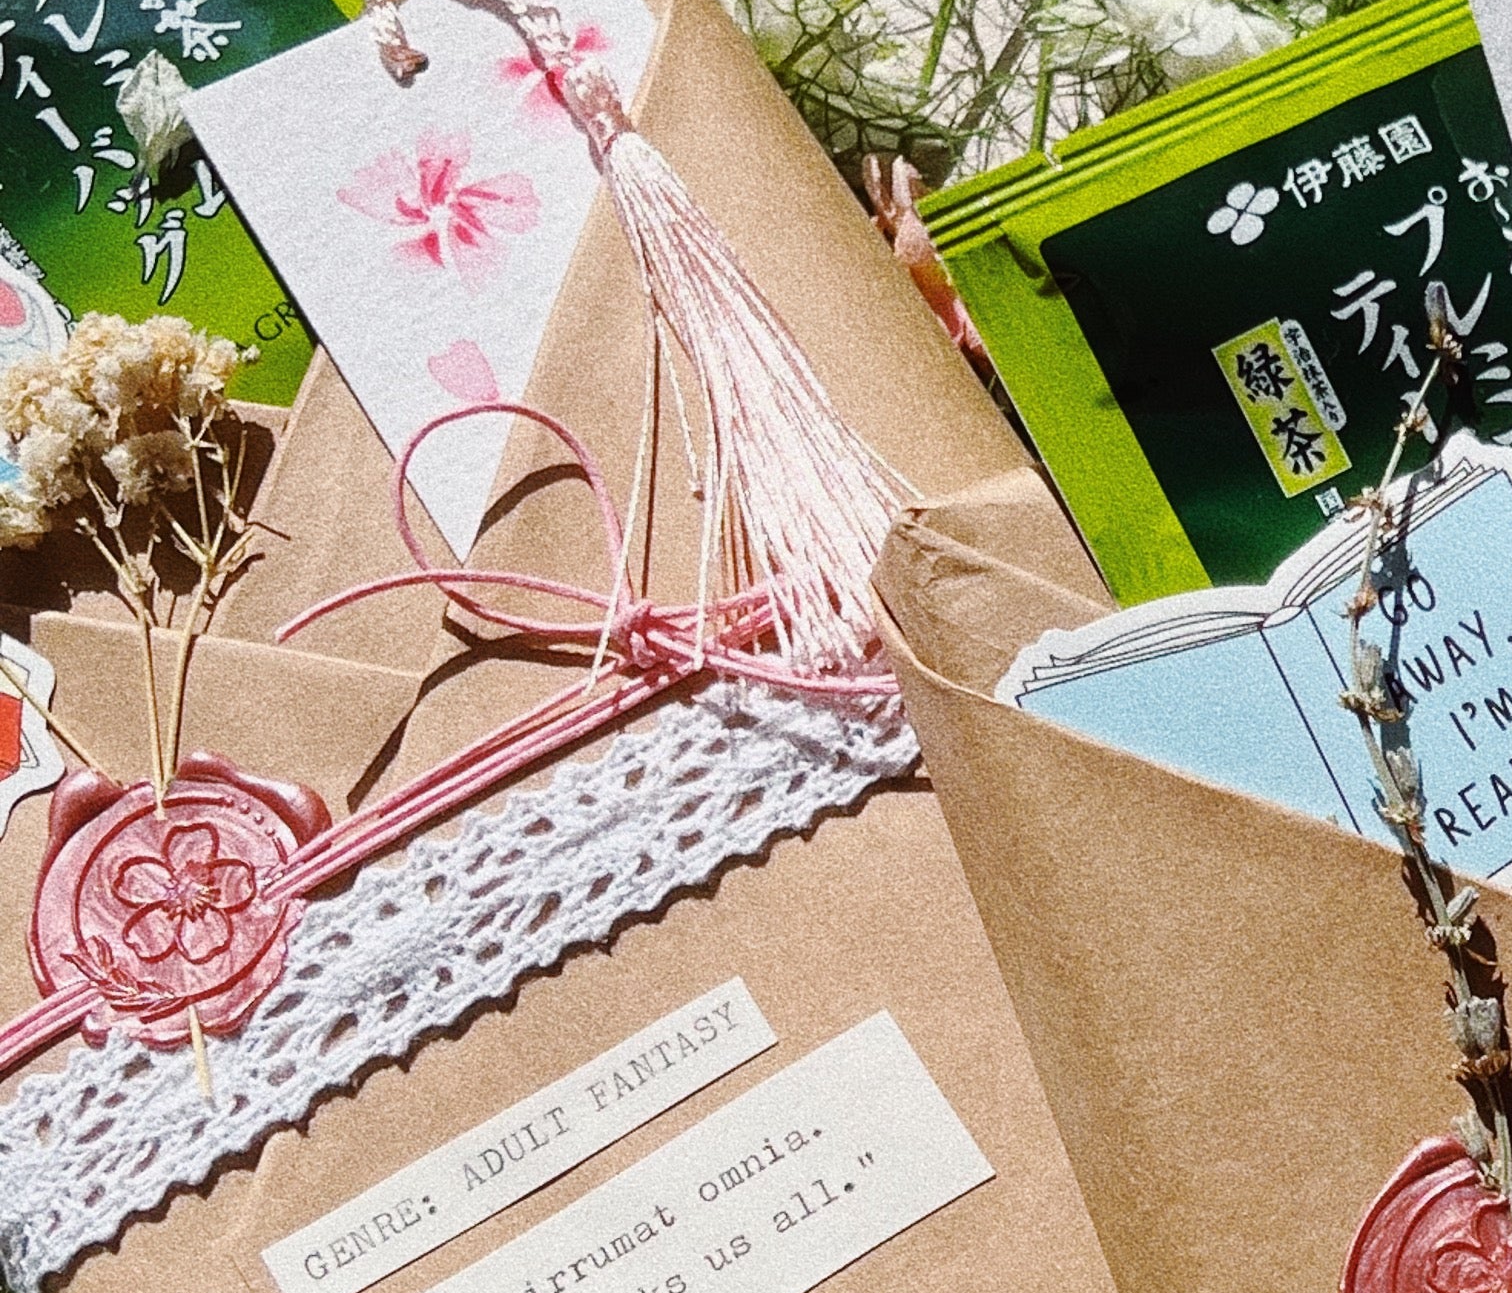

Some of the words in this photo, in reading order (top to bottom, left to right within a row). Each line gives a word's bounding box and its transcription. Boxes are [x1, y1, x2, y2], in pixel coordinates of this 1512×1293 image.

[1282, 114, 1433, 210] 伊藤園
[1234, 341, 1328, 477] 緑茶
[1378, 574, 1436, 627] GO
[304, 1192, 439, 1283] GENRE:
[463, 1106, 572, 1192] ADULT
[586, 1001, 741, 1113] FANTASY
[698, 1126, 825, 1202] omnia.
[704, 1232, 753, 1273] us
[774, 1150, 877, 1235] all."
